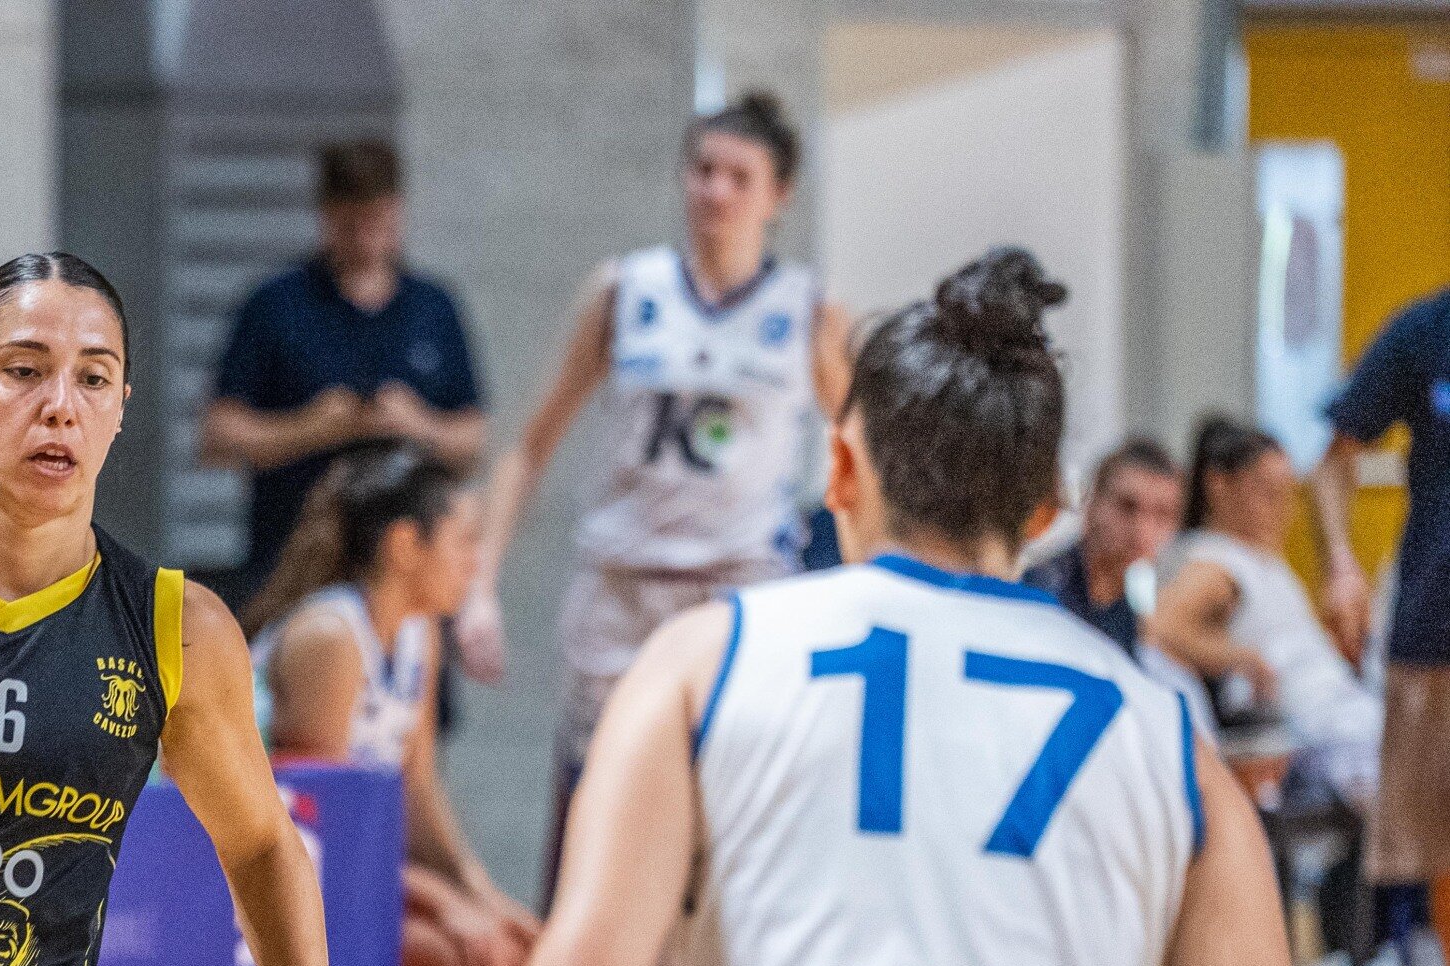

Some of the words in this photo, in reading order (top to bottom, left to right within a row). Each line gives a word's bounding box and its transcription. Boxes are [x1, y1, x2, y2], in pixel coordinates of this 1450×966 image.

[96, 656, 144, 681] BASKE
[92, 711, 138, 738] CAVEZZO
[810, 624, 1123, 858] 17
